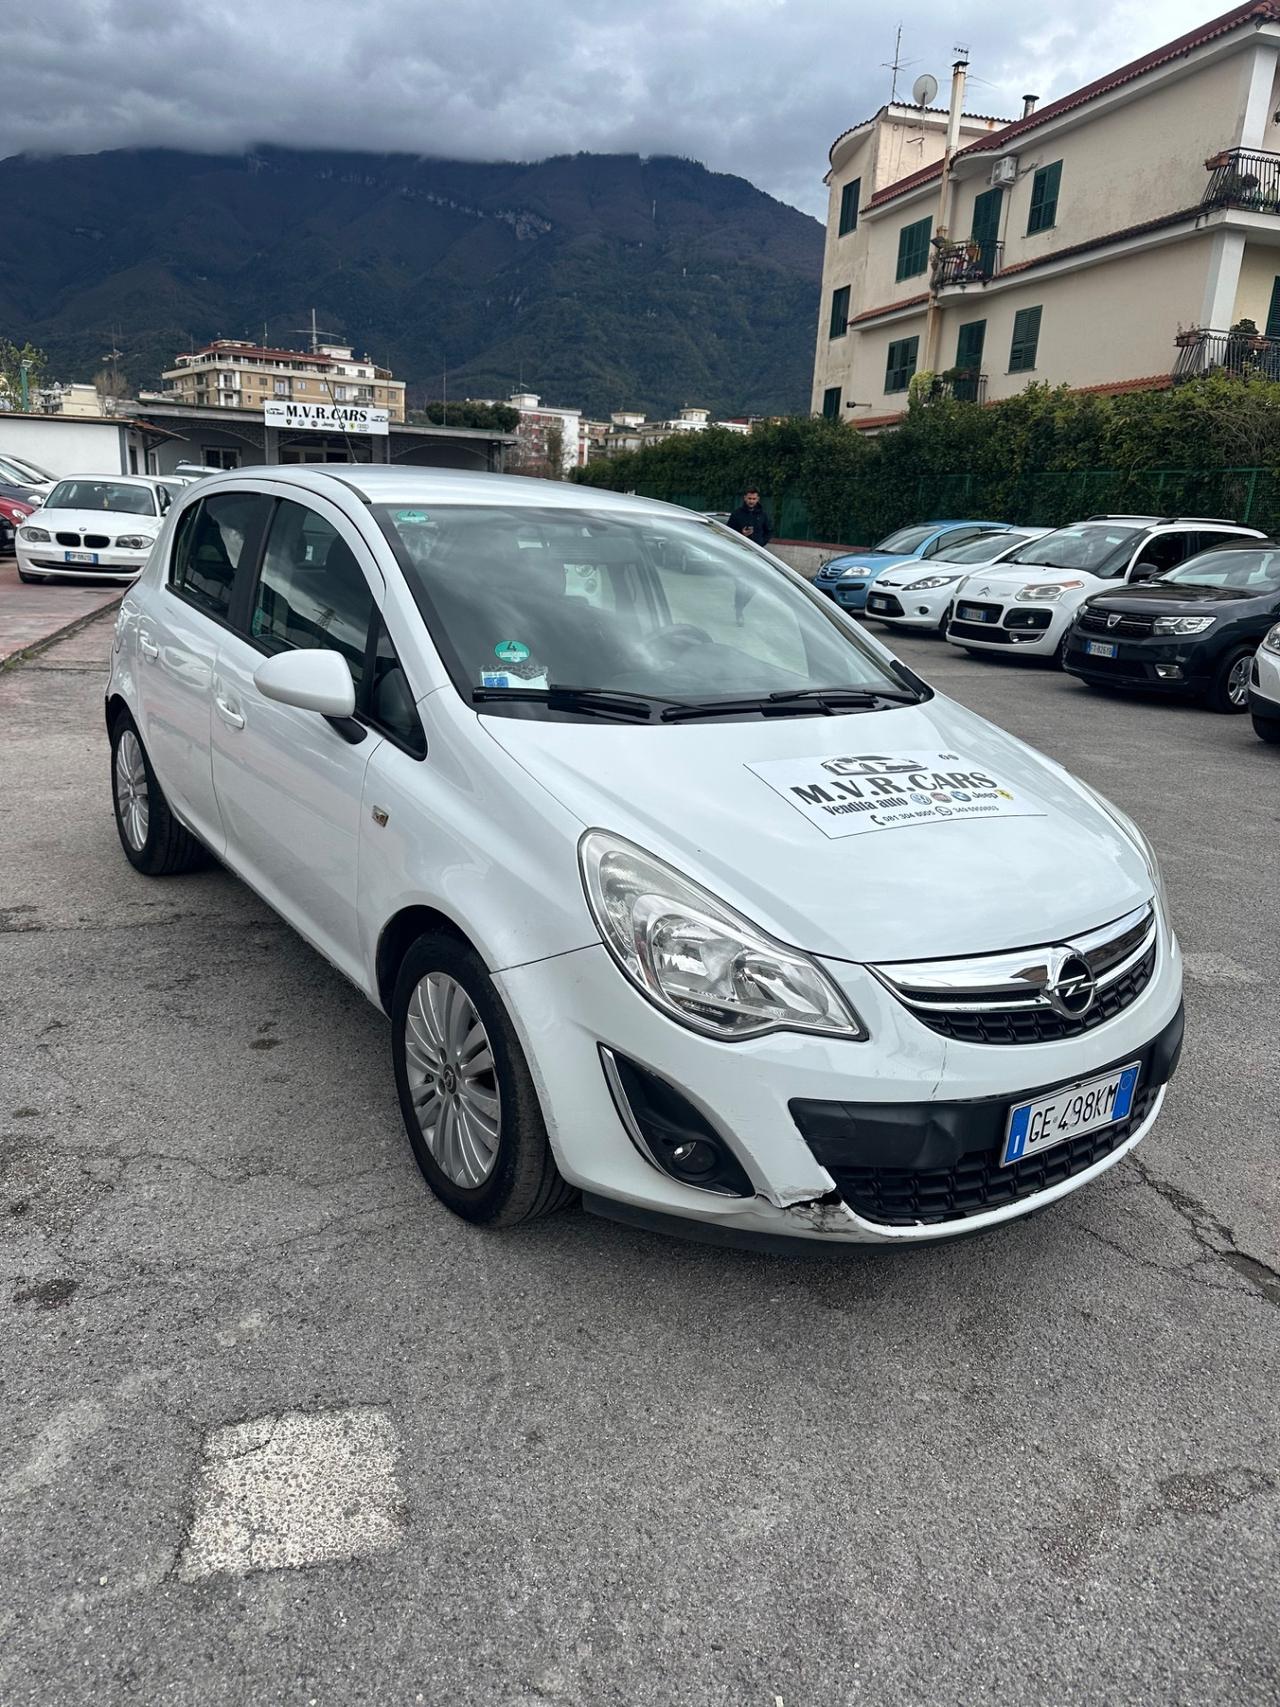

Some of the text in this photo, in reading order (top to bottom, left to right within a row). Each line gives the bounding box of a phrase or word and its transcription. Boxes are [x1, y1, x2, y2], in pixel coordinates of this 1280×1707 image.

[286, 404, 368, 422] M.V.R.CARS
[790, 772, 998, 805] M.V.R.CARS
[822, 797, 908, 816] Vendita auto
